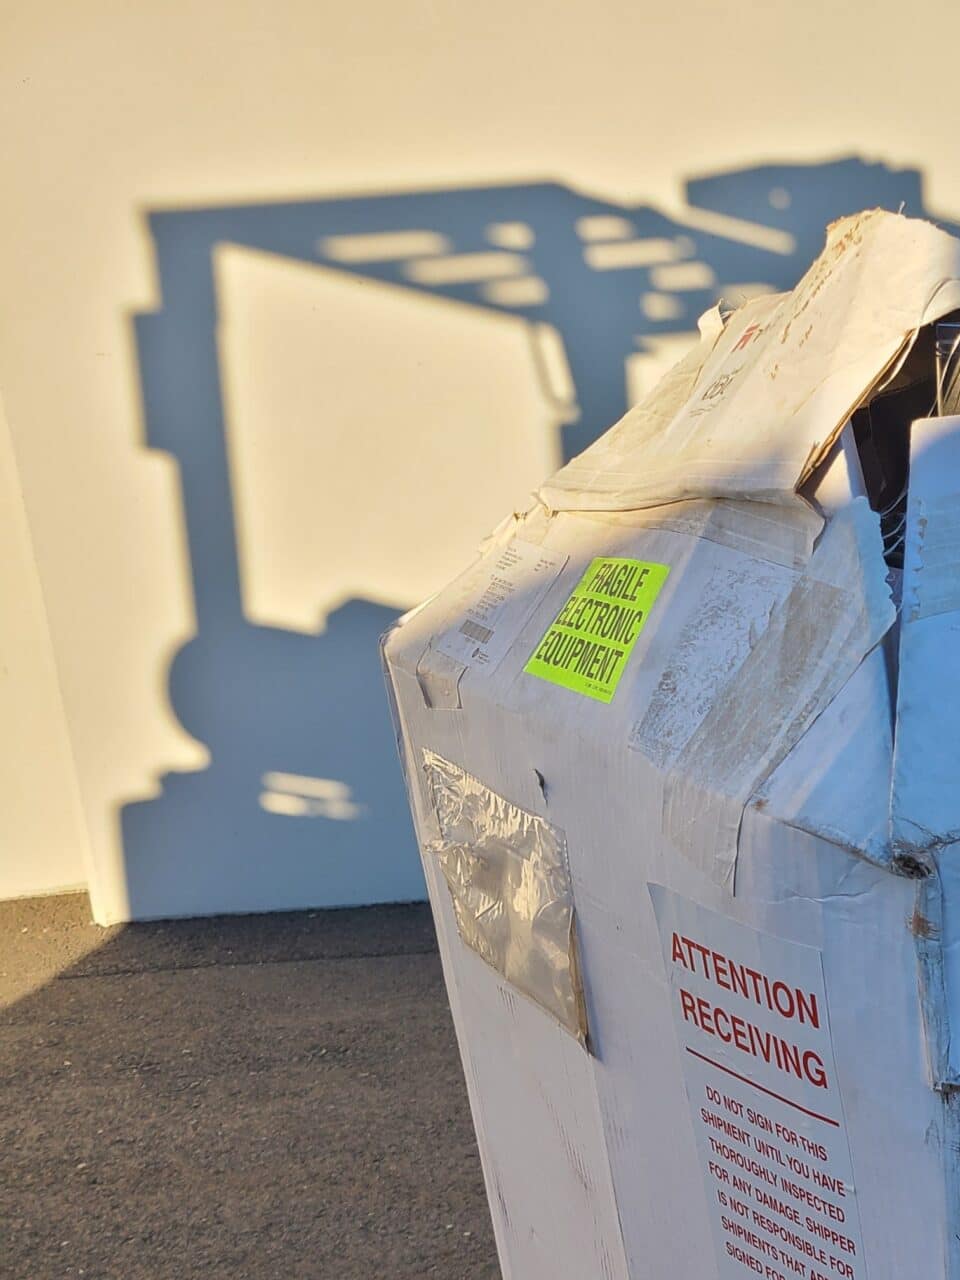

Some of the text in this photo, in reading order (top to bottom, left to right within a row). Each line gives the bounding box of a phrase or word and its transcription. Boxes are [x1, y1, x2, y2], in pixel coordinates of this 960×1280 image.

[555, 596, 643, 645] ELECTRONIC
[586, 563, 650, 602] FRAGILE
[535, 630, 625, 684] EQUIPMENT
[672, 932, 820, 1029] ATTENTION
[680, 988, 828, 1089] RECEIVING
[701, 1108, 846, 1197] SHIPMENT UNTIL YOU HAVE
[706, 1085, 828, 1161] DO NOT SIGN FOR THIS
[708, 1136, 845, 1222] THOROUGHLY INSPECTED
[708, 1161, 856, 1256] FOR ANY DAMAGE. SHIPPER
[717, 1189, 855, 1280] IS NOT RESPONSIBLE FOR
[721, 1216, 778, 1261] SHIPMENTS
[779, 1251, 806, 1277] THAT
[726, 1241, 763, 1274] SIGNED
